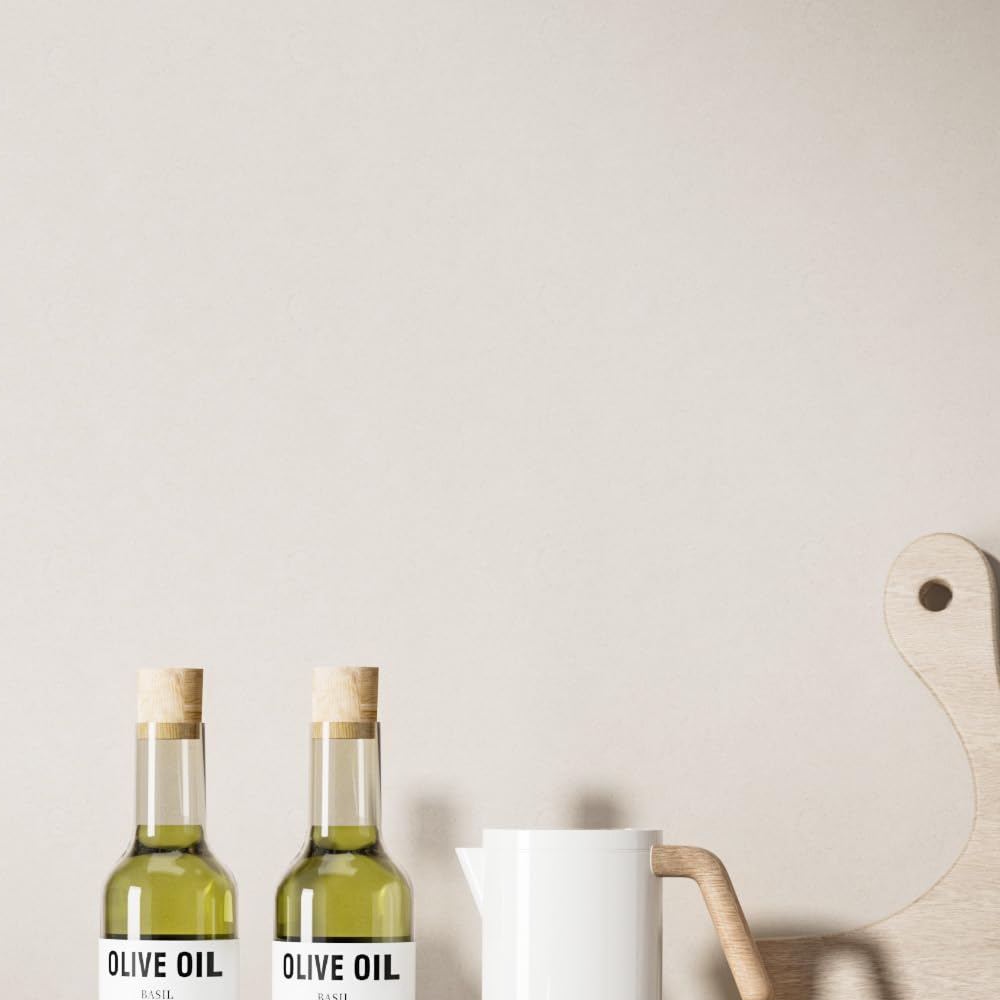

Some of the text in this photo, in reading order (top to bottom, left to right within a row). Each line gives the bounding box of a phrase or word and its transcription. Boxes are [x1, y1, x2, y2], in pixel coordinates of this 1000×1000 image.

[108, 950, 223, 978] OLIVE OIL
[283, 952, 401, 981] OLIVE OIL
[141, 989, 174, 1000] BASIL
